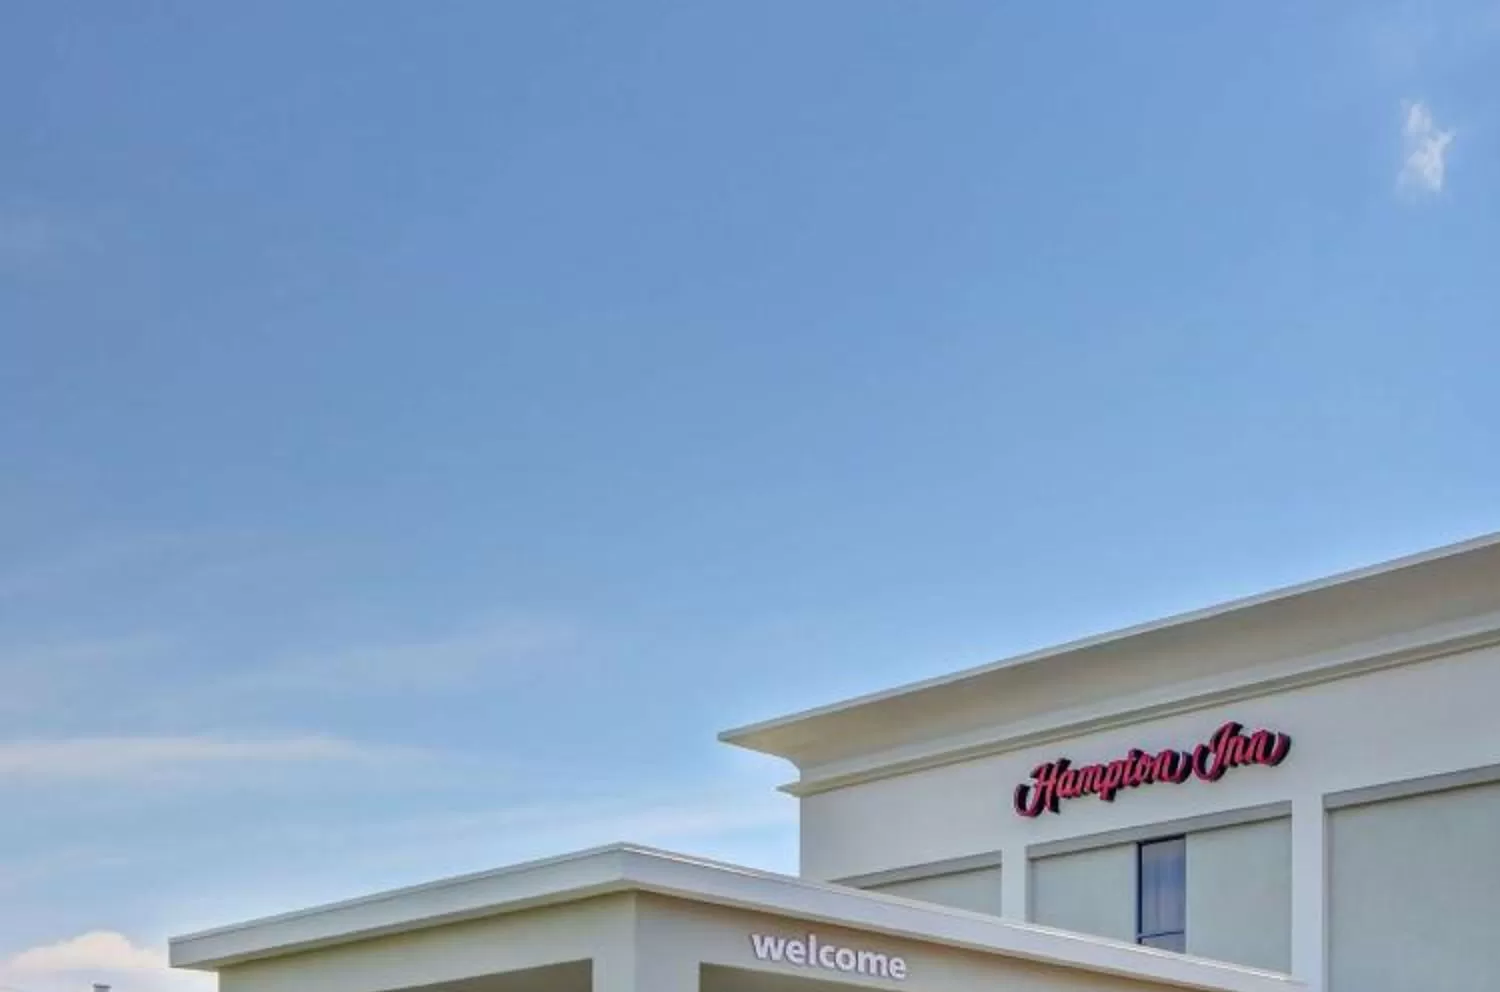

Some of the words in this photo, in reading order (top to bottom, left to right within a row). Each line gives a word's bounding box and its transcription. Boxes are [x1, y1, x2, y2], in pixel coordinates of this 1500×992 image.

[1014, 748, 1193, 817] Hampton
[1192, 721, 1291, 782] Inn
[751, 933, 906, 979] welcome
